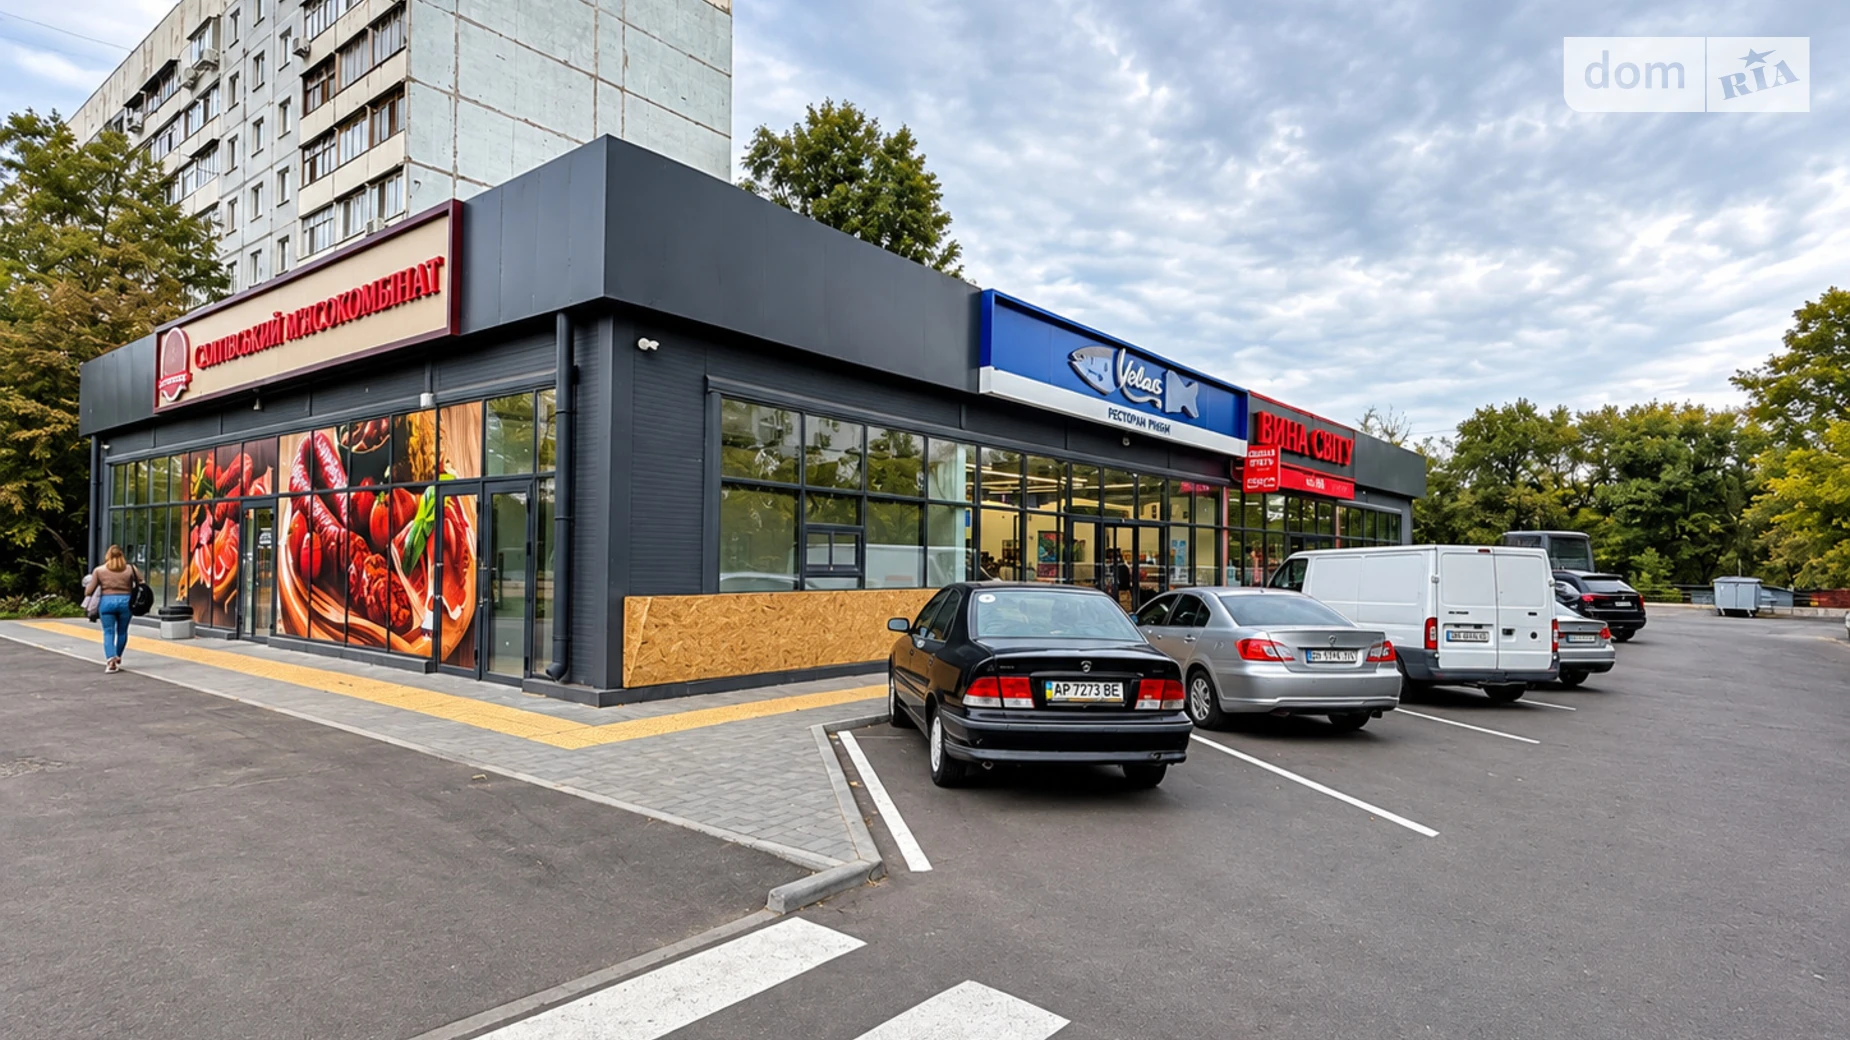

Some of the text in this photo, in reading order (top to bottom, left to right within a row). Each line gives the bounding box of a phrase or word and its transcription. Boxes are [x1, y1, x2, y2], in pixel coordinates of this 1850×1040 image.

[1257, 410, 1310, 458] ВИНА
[1310, 429, 1354, 466] СВІТУ
[1054, 683, 1120, 697] AP 7273 BE
